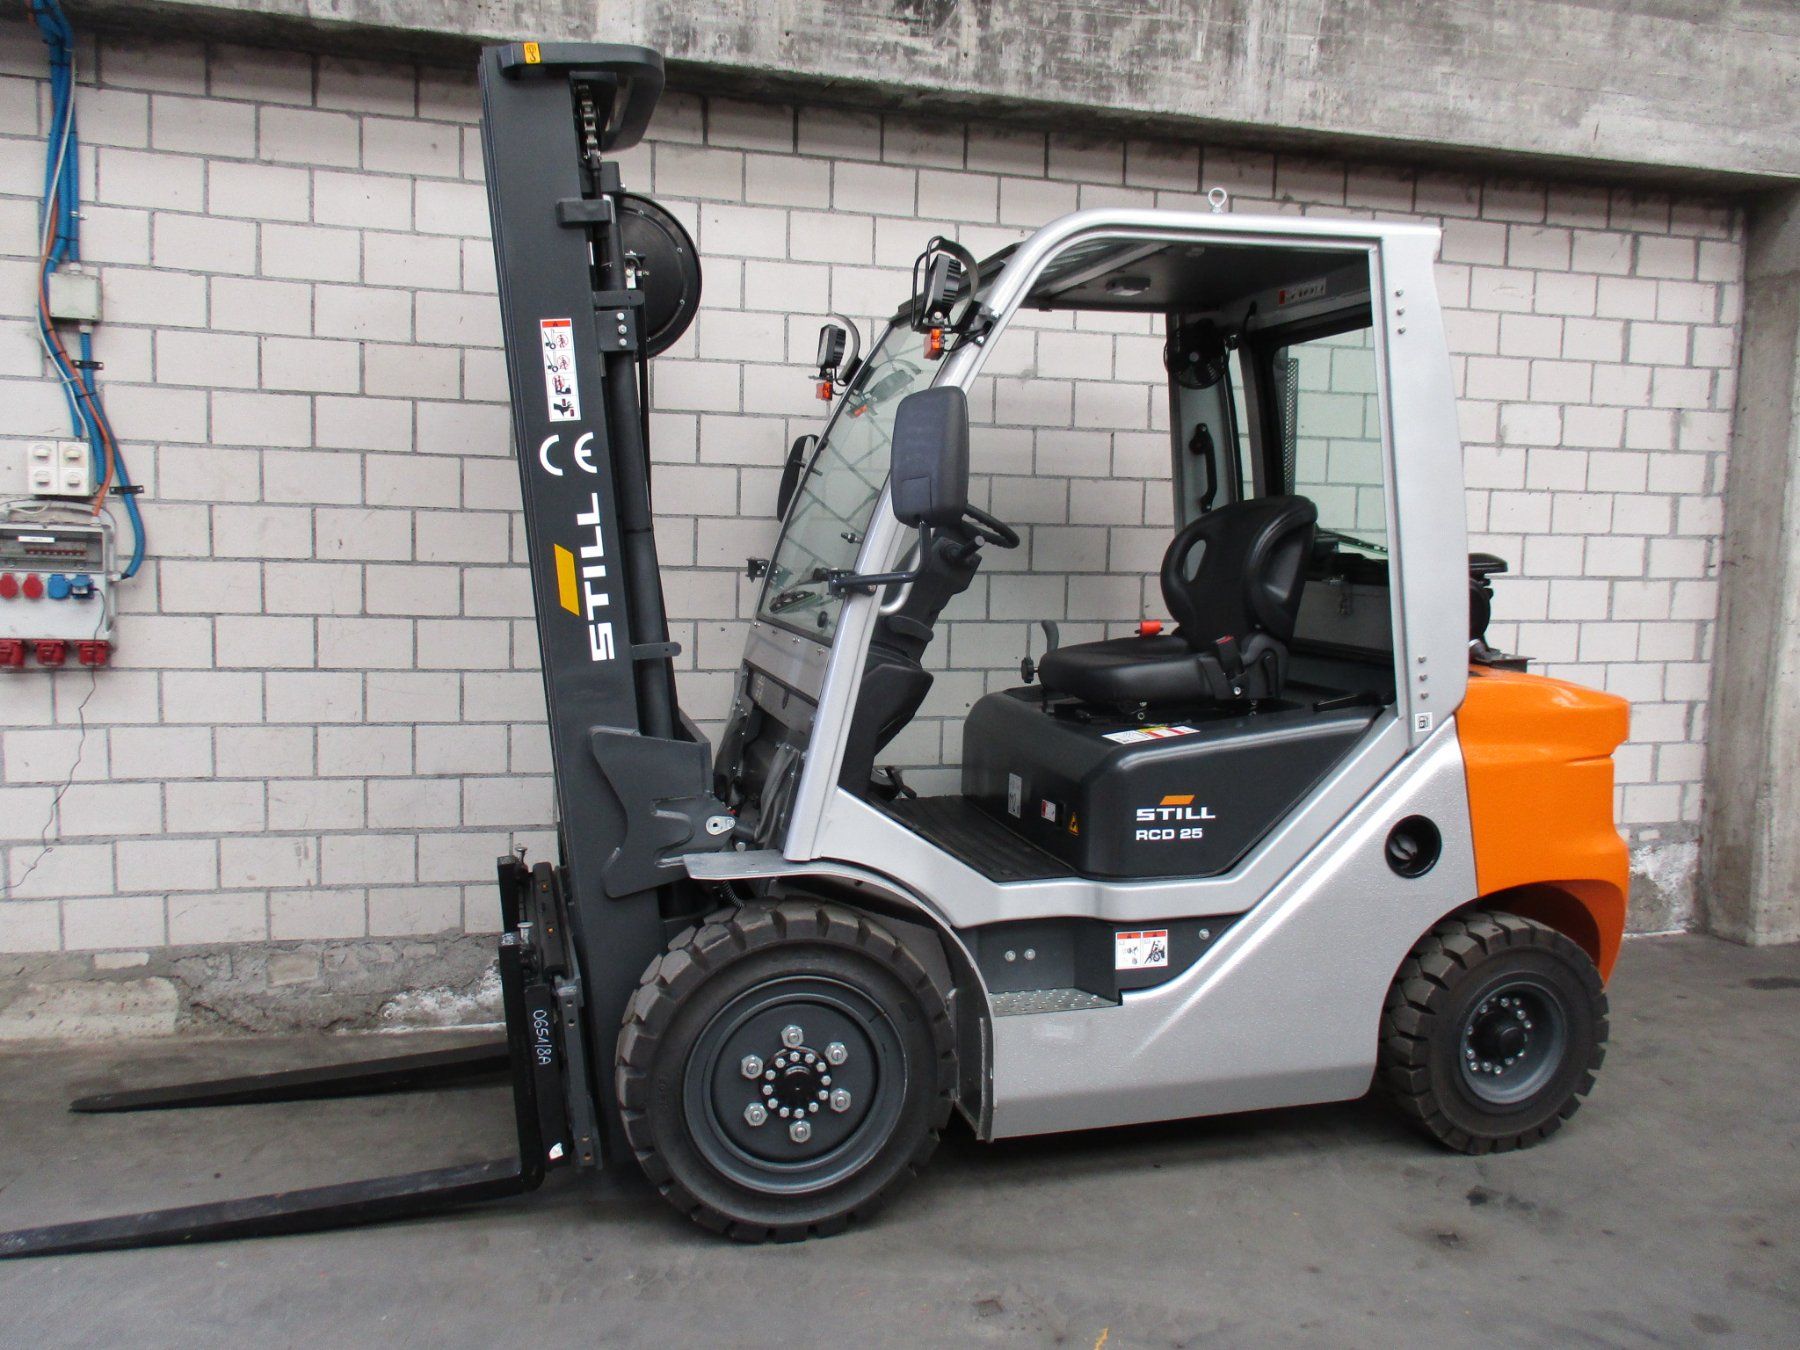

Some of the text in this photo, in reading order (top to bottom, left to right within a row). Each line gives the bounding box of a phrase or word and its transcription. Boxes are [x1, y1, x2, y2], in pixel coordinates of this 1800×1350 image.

[540, 432, 598, 476] CE
[577, 492, 615, 661] STILL
[1136, 807, 1216, 821] STILL
[1136, 828, 1203, 840] RCD 25
